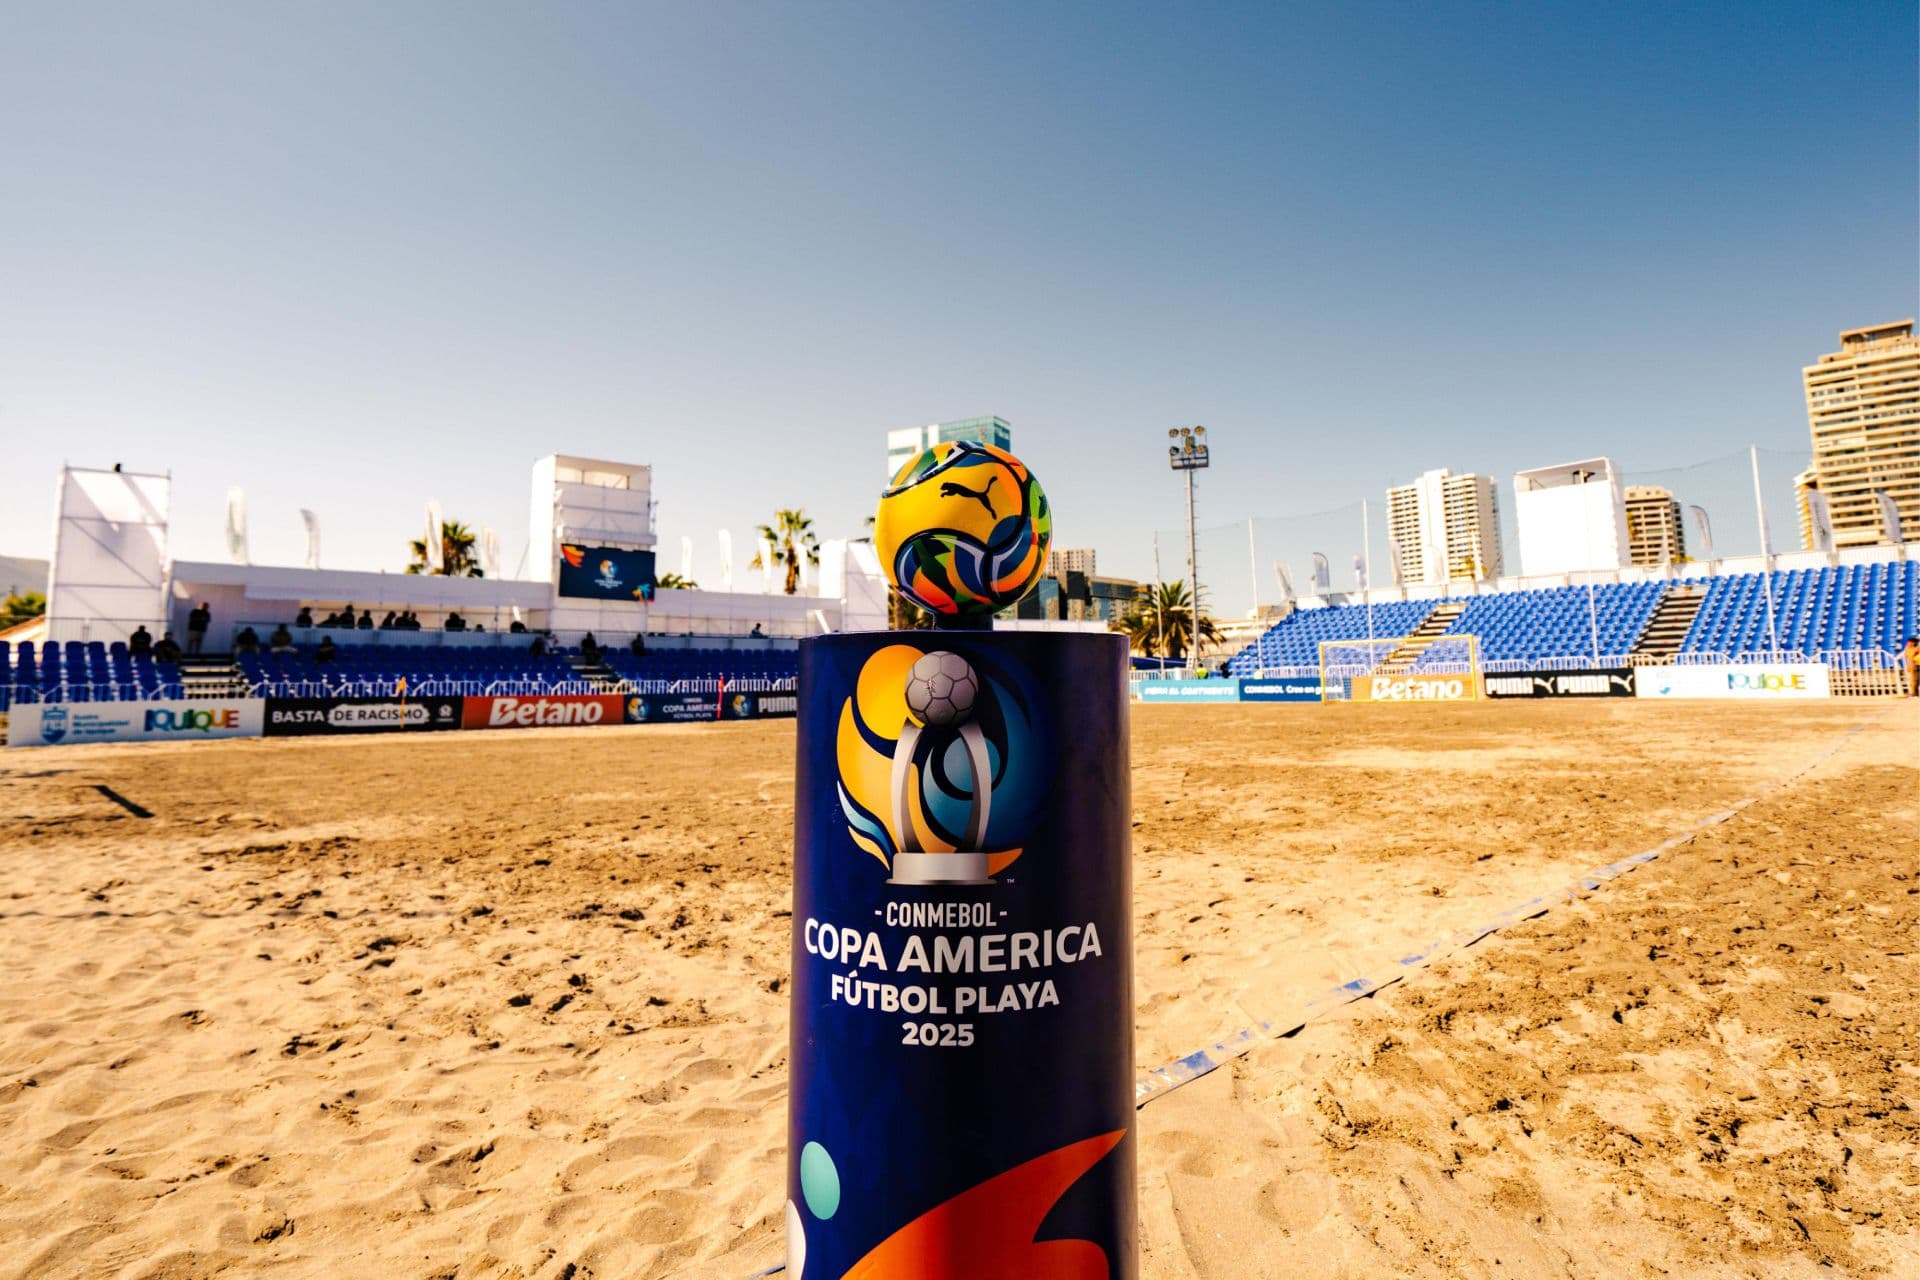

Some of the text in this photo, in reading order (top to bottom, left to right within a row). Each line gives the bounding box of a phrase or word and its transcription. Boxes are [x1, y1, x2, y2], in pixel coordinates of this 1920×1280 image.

[1371, 676, 1463, 700] Betano
[1486, 678, 1533, 694] PUMA
[1558, 676, 1610, 693] PUMA
[272, 708, 424, 723] BASTA DE RACISMO
[489, 697, 603, 726] Betano
[662, 704, 685, 713] COPA
[758, 697, 797, 713] PUMA
[144, 709, 240, 732] IQUIQUE
[804, 917, 1102, 974] COPA AMERICA
[831, 970, 1060, 1014] FÚTBOL PLAYA
[901, 1021, 975, 1046] 2025
